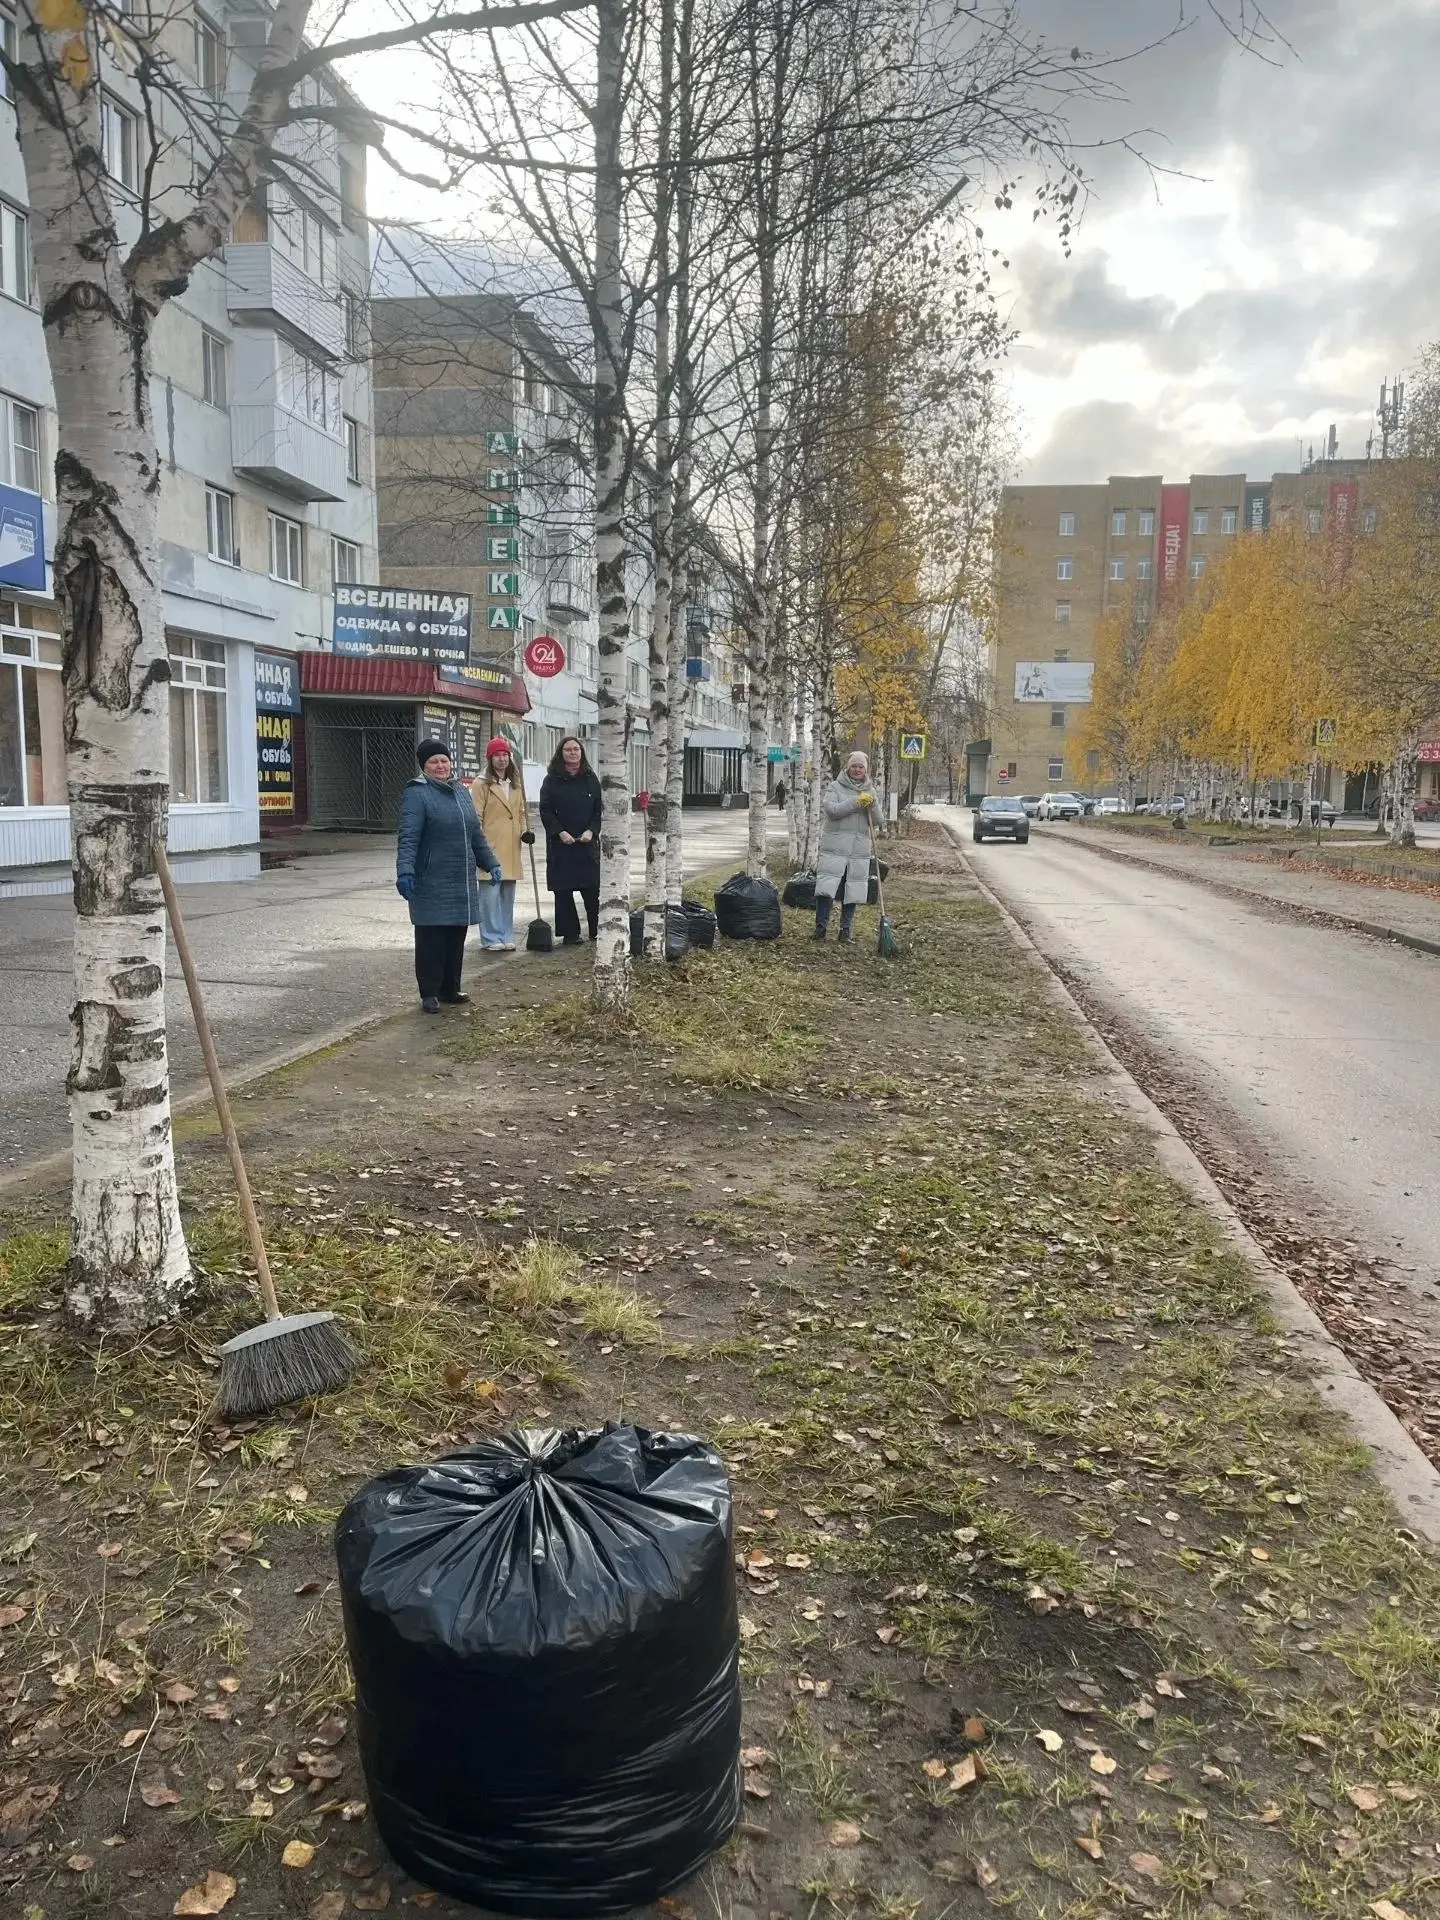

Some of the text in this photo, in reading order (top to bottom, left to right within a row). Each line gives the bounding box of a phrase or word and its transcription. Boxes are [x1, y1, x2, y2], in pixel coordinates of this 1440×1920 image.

[1252, 498, 1264, 531] ИМСЯ!
[489, 432, 509, 628] АПТЕКА
[336, 588, 469, 622] ВСЕЛЕННАЯ
[336, 616, 468, 637] ОДЕЖДА ОБУВЬ
[377, 644, 418, 656] ДЕШЕВО
[422, 647, 429, 656] И
[434, 648, 465, 659] ТОЧКА
[532, 644, 557, 664] 24
[255, 661, 291, 691] ННАЯ
[265, 690, 292, 706] ОБУВЬ
[257, 716, 291, 744] ННАЯ
[262, 749, 291, 764] ОБУВЬ
[259, 796, 291, 807] ОРТИМЕНТ
